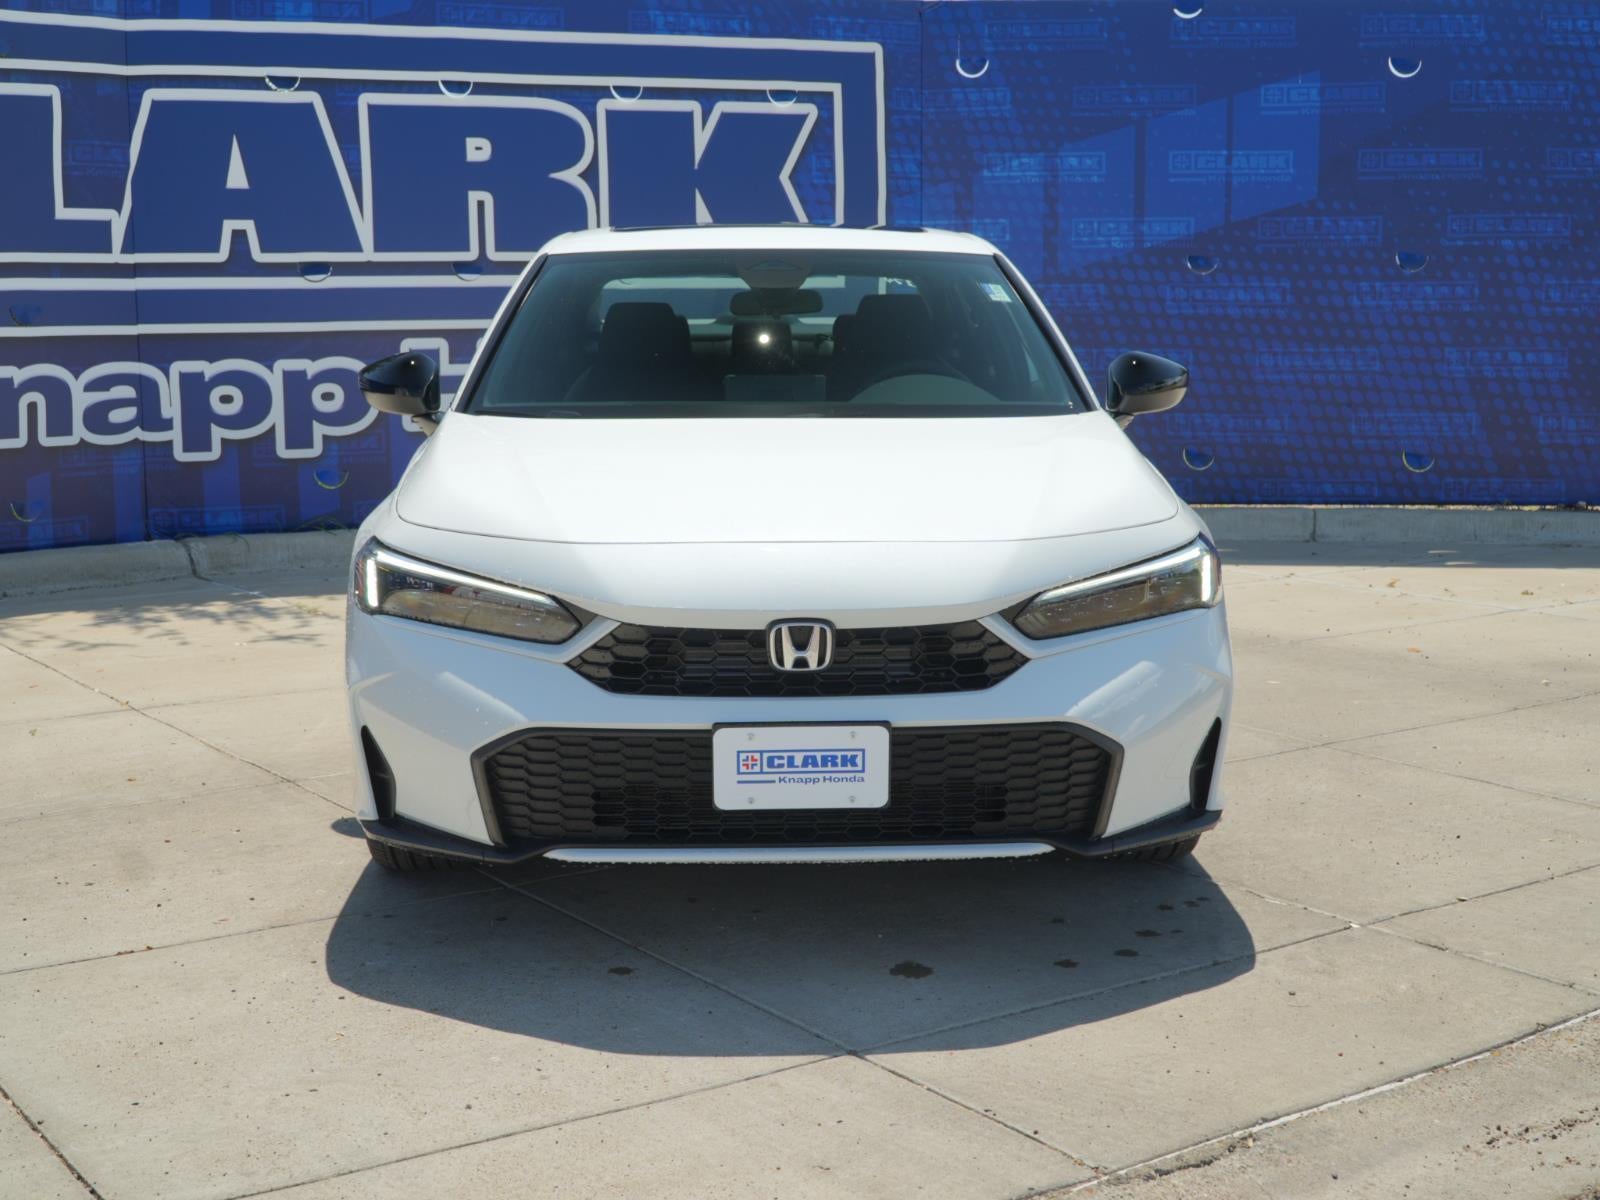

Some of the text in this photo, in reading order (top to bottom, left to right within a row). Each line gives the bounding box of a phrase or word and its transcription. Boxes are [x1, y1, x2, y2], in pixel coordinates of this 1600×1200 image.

[1197, 155, 1287, 169] CLARK
[766, 754, 859, 769] CLARK
[778, 774, 865, 785] Knapp Honda
